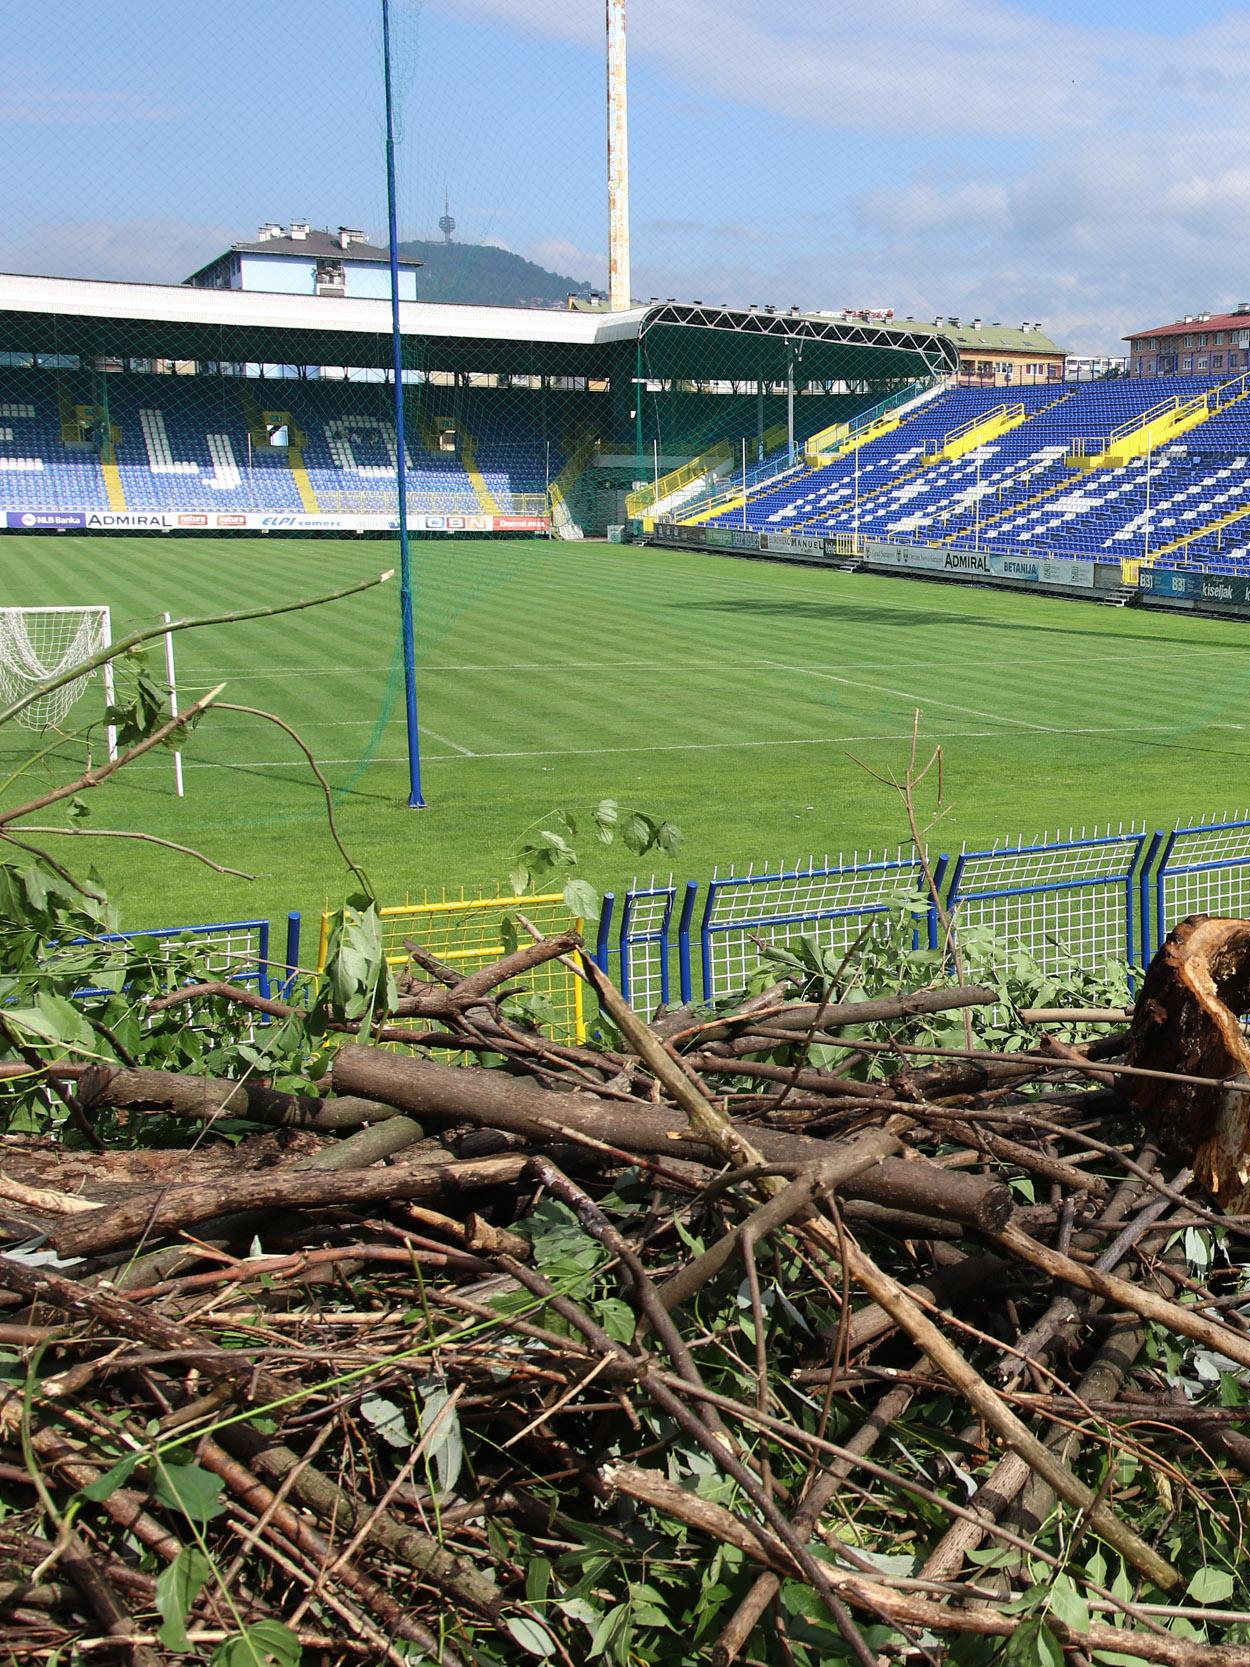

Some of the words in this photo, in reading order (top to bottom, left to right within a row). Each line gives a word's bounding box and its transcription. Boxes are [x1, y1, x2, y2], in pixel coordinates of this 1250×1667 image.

[37, 515, 56, 524] NLB
[56, 516, 81, 525] Banka
[88, 515, 173, 527] ADMIRAL
[262, 517, 296, 526] ELPI
[791, 537, 823, 550] MANUEL
[944, 552, 990, 573] ADMIRAL
[1003, 561, 1037, 575] BETANIJA
[1202, 582, 1233, 599] kiseljak
